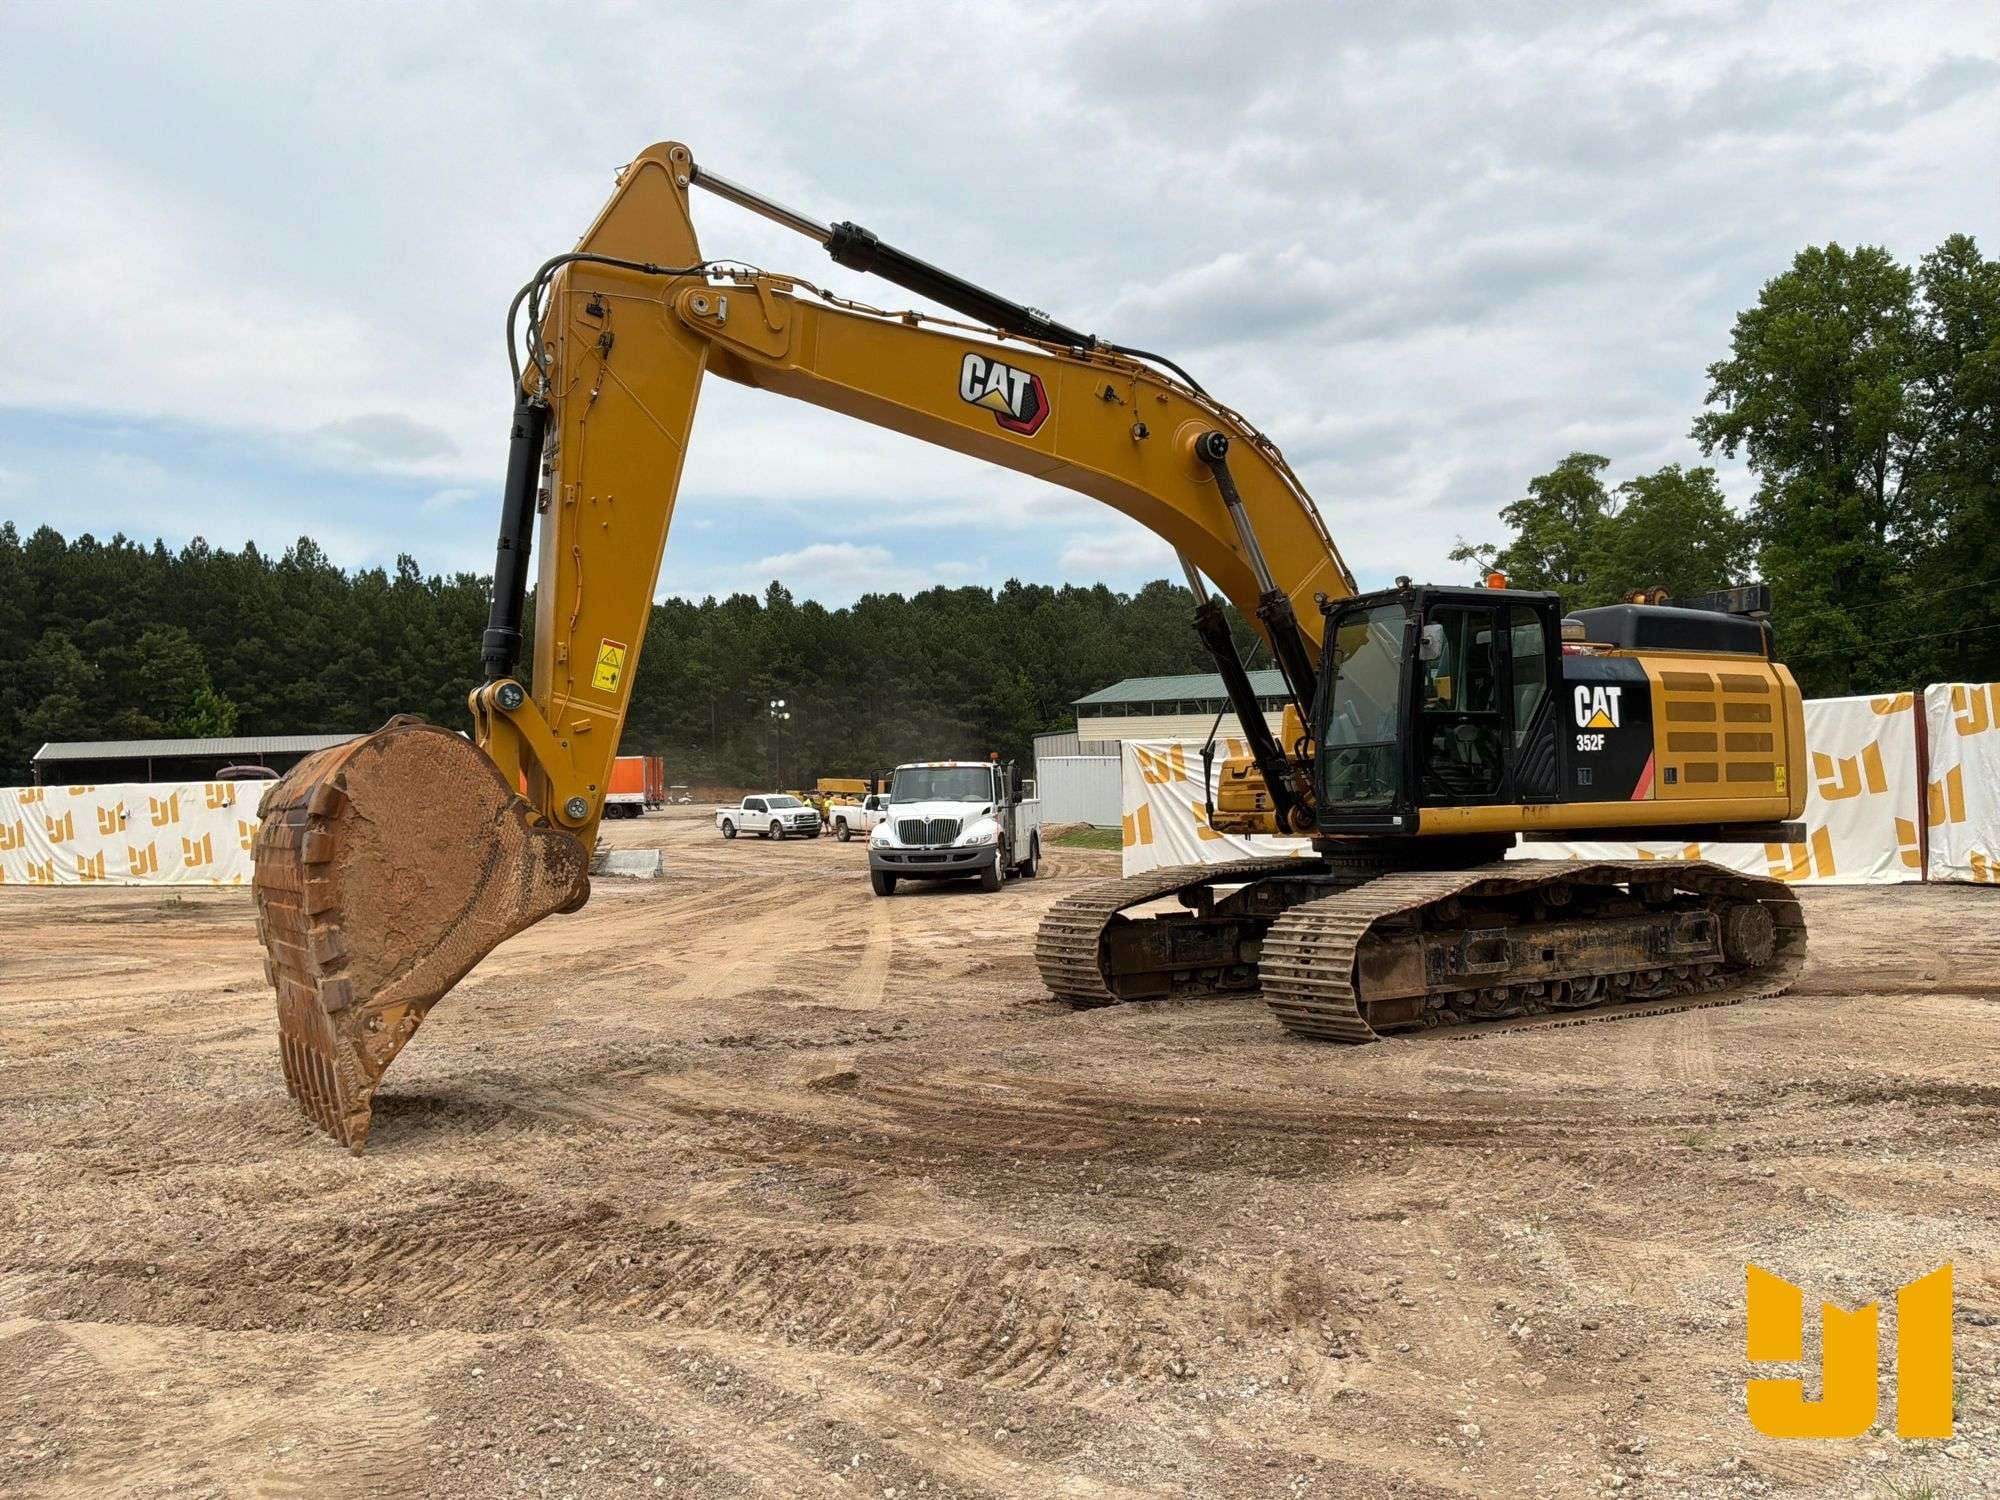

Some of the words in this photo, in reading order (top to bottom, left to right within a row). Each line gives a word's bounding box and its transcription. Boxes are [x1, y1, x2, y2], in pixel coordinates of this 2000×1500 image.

[961, 354, 1031, 417] CAT
[1574, 685, 1622, 728] CAT
[1576, 734, 1604, 752] 352F
